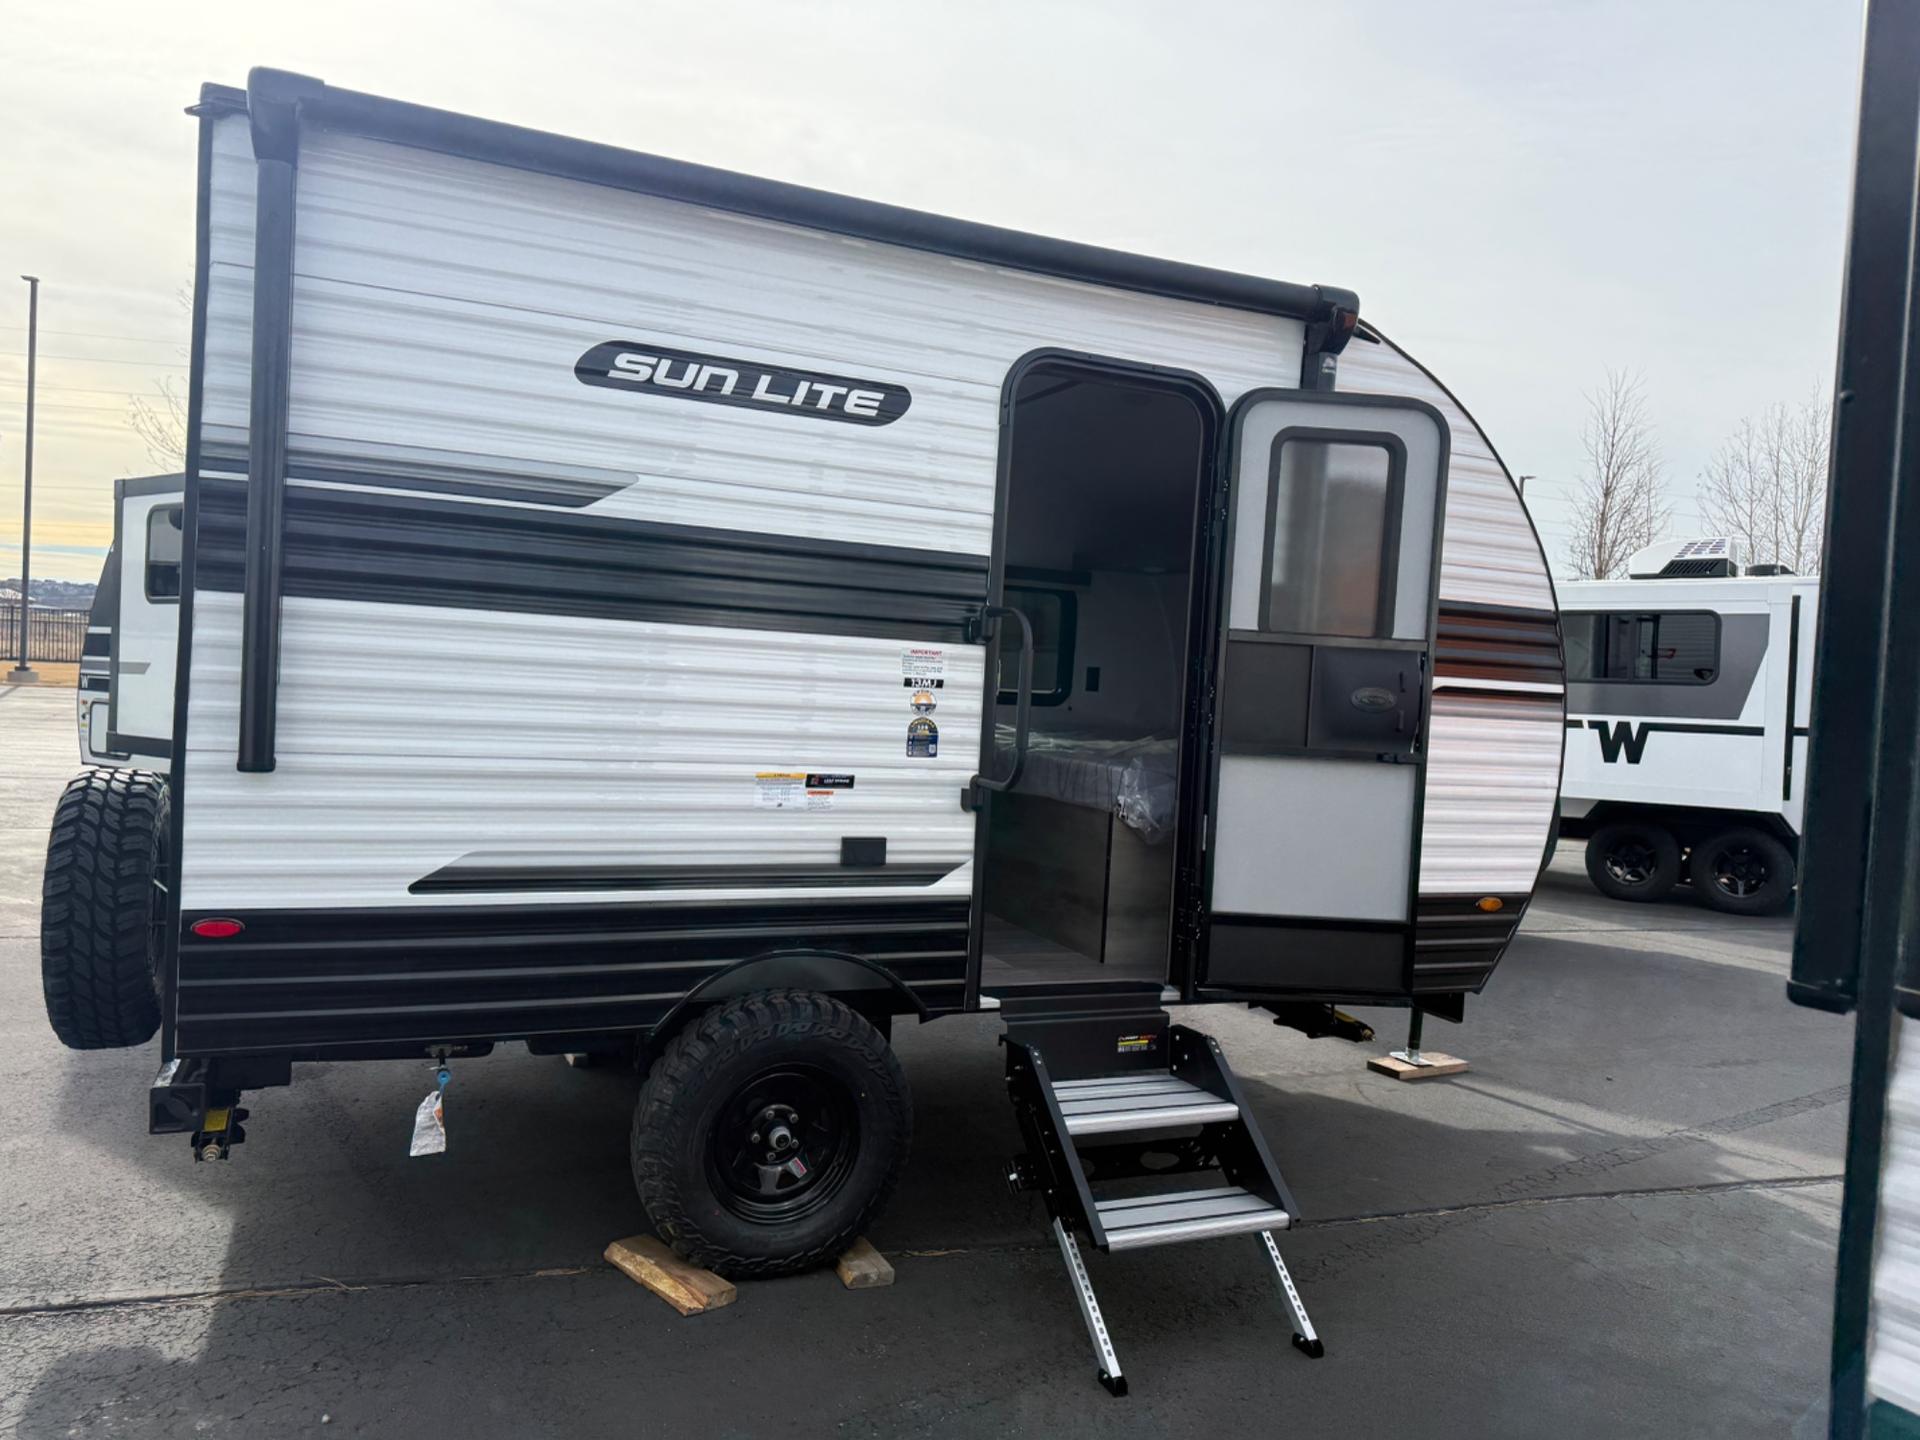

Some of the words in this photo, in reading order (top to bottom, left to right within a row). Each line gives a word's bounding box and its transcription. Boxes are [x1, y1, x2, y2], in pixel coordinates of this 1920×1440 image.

[607, 352, 739, 395] SUN
[752, 375, 885, 417] LITE
[1588, 720, 1649, 764] W
